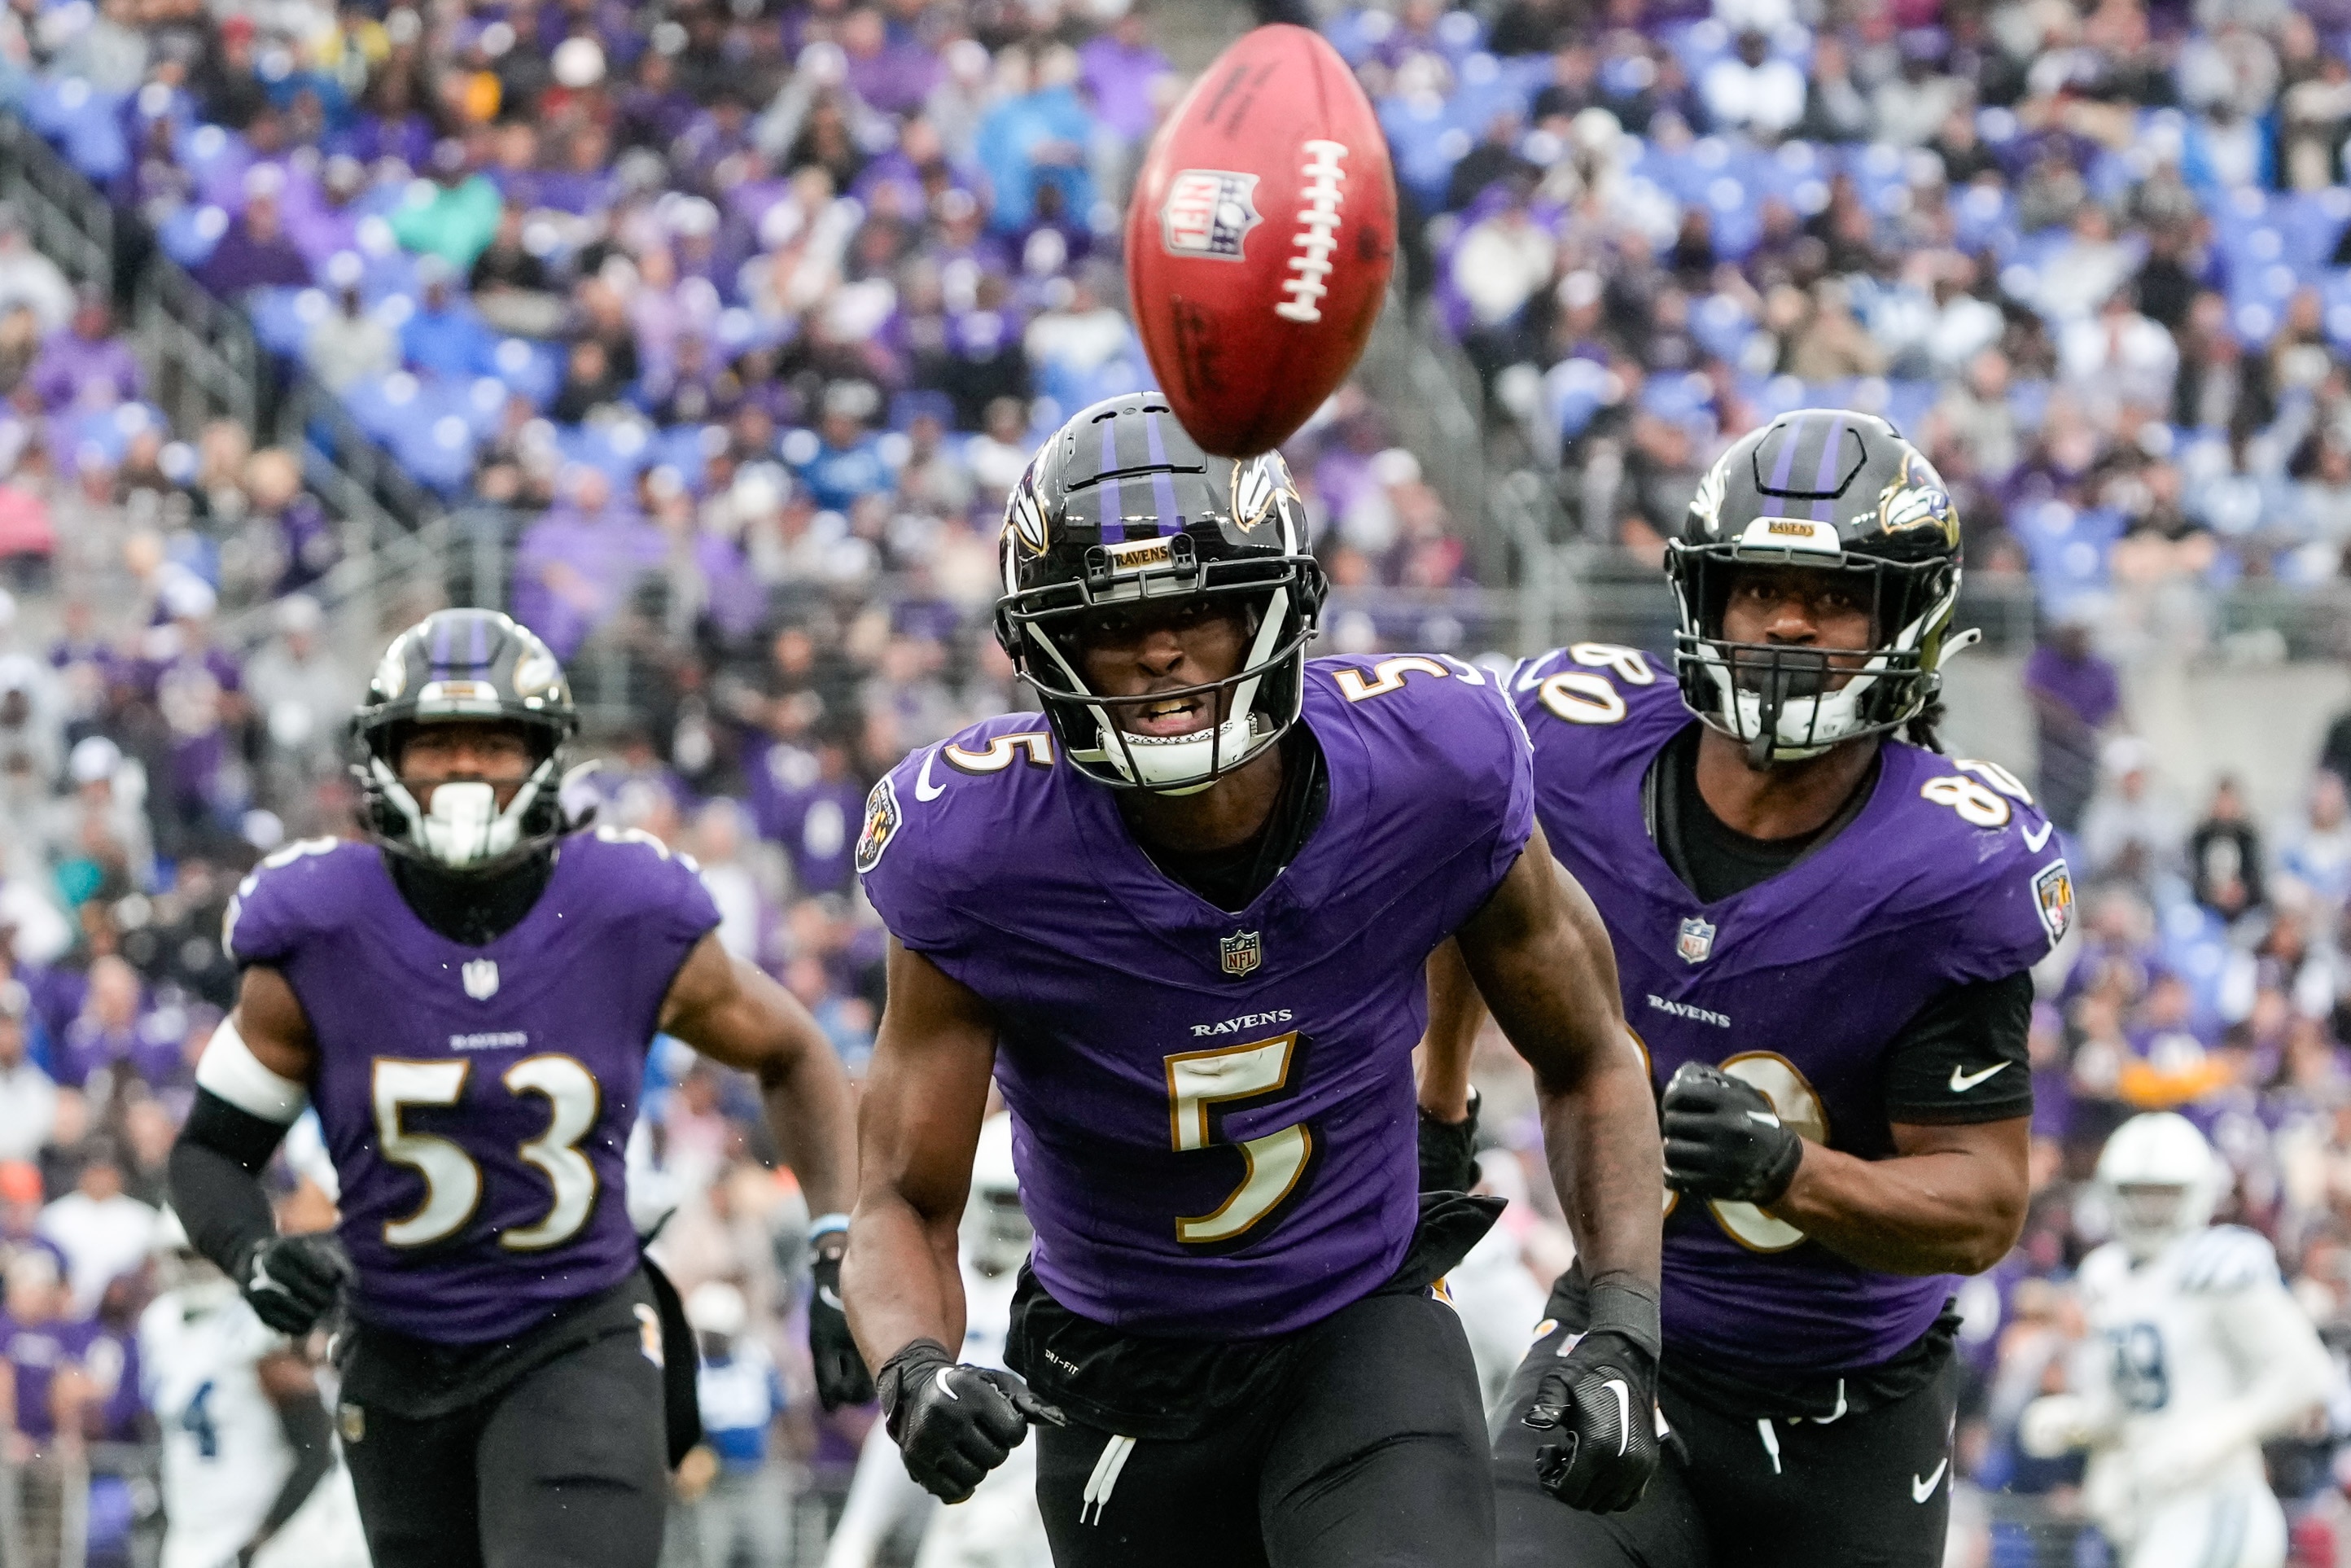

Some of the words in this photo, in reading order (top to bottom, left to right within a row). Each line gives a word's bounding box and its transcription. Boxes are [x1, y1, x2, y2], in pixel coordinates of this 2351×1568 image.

[1172, 182, 1215, 243] NFL
[1113, 545, 1169, 568] RAVENS
[1332, 656, 1451, 703] 5
[940, 731, 1055, 776] 5
[1228, 950, 1255, 969] NFL
[1189, 1009, 1293, 1037] RAVENS
[1647, 993, 1732, 1028] RAVENS
[371, 1052, 601, 1252] 53
[1163, 1030, 1314, 1244] 5
[1044, 1348, 1079, 1375] DRI-FIT
